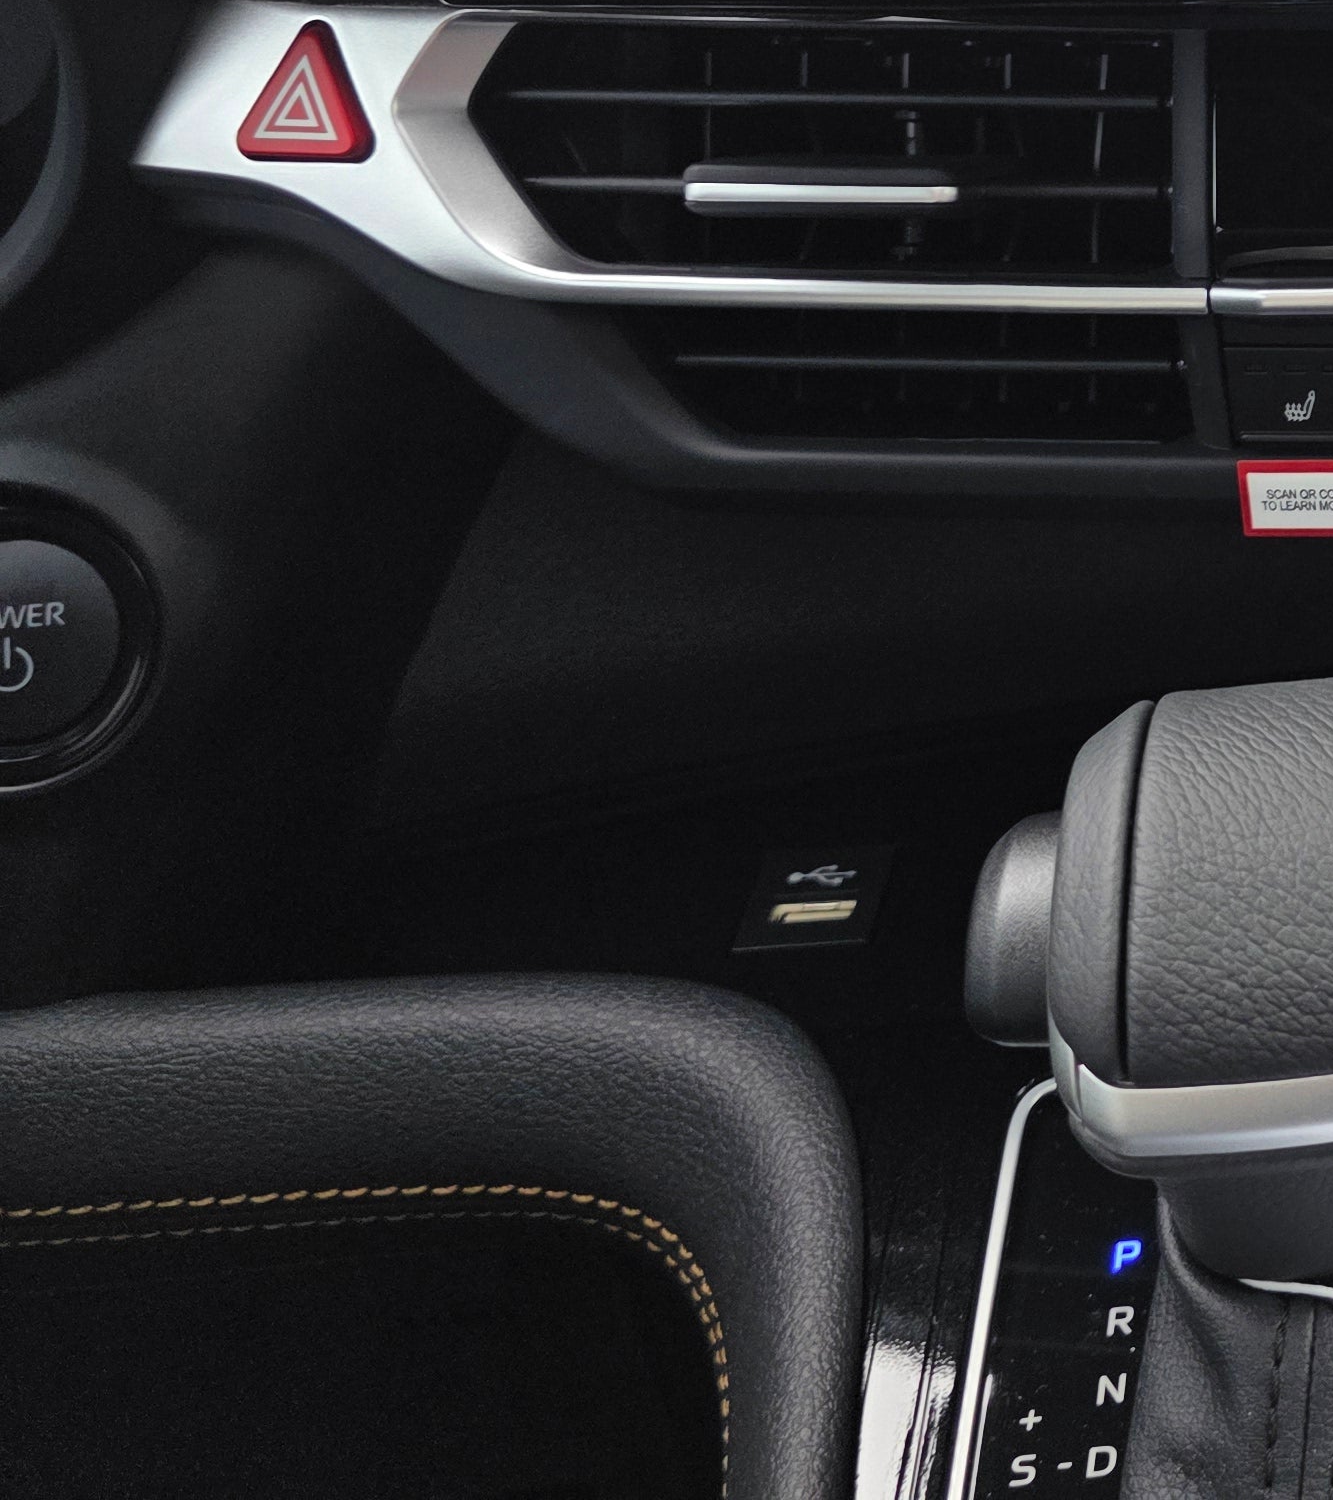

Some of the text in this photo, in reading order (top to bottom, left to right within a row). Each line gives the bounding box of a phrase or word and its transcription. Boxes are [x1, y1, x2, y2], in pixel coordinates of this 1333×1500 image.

[1262, 501, 1278, 511] TO
[1280, 501, 1317, 511] LEARN
[1266, 488, 1297, 499] SCAN
[1300, 488, 1318, 499] QR
[1111, 1238, 1142, 1274] P
[1106, 1305, 1135, 1337] R
[1095, 1372, 1128, 1406] N
